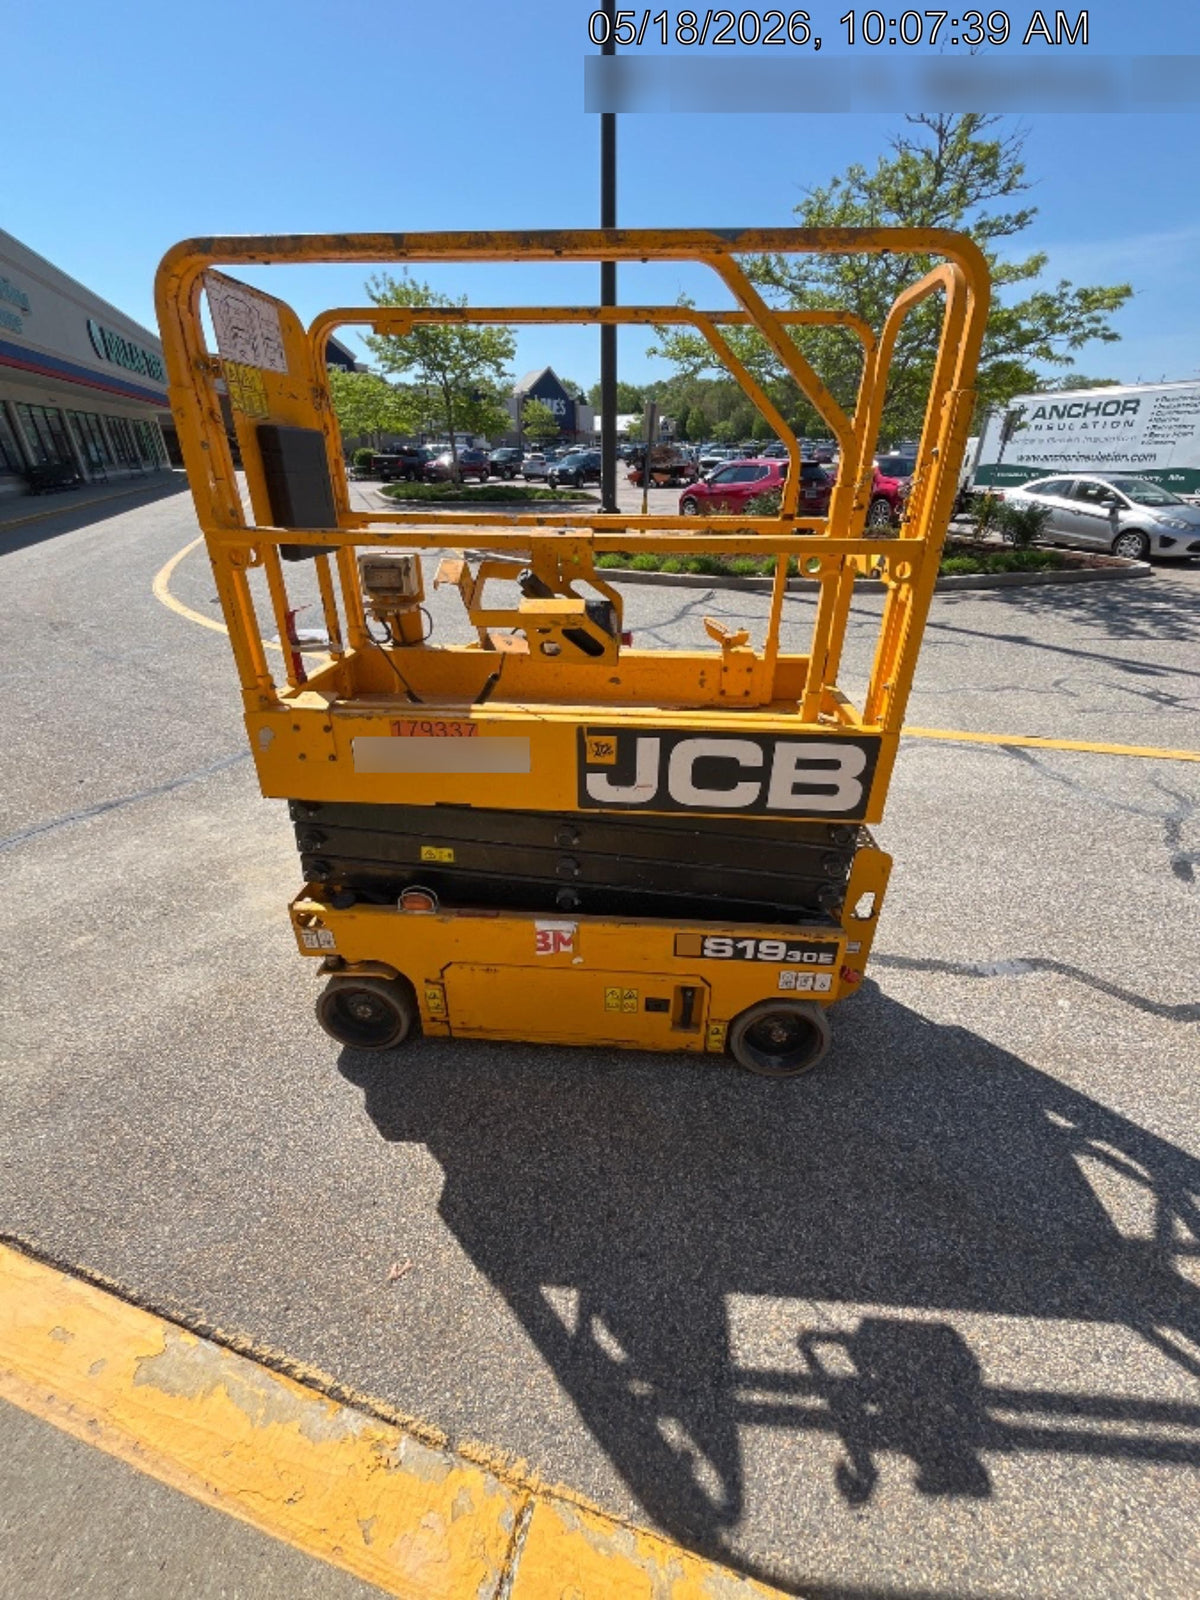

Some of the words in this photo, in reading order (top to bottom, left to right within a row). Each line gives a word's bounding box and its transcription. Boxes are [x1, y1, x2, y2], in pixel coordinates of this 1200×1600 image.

[1031, 398, 1141, 420] ANCHOR
[392, 721, 478, 737] 179337
[586, 737, 867, 811] JCB
